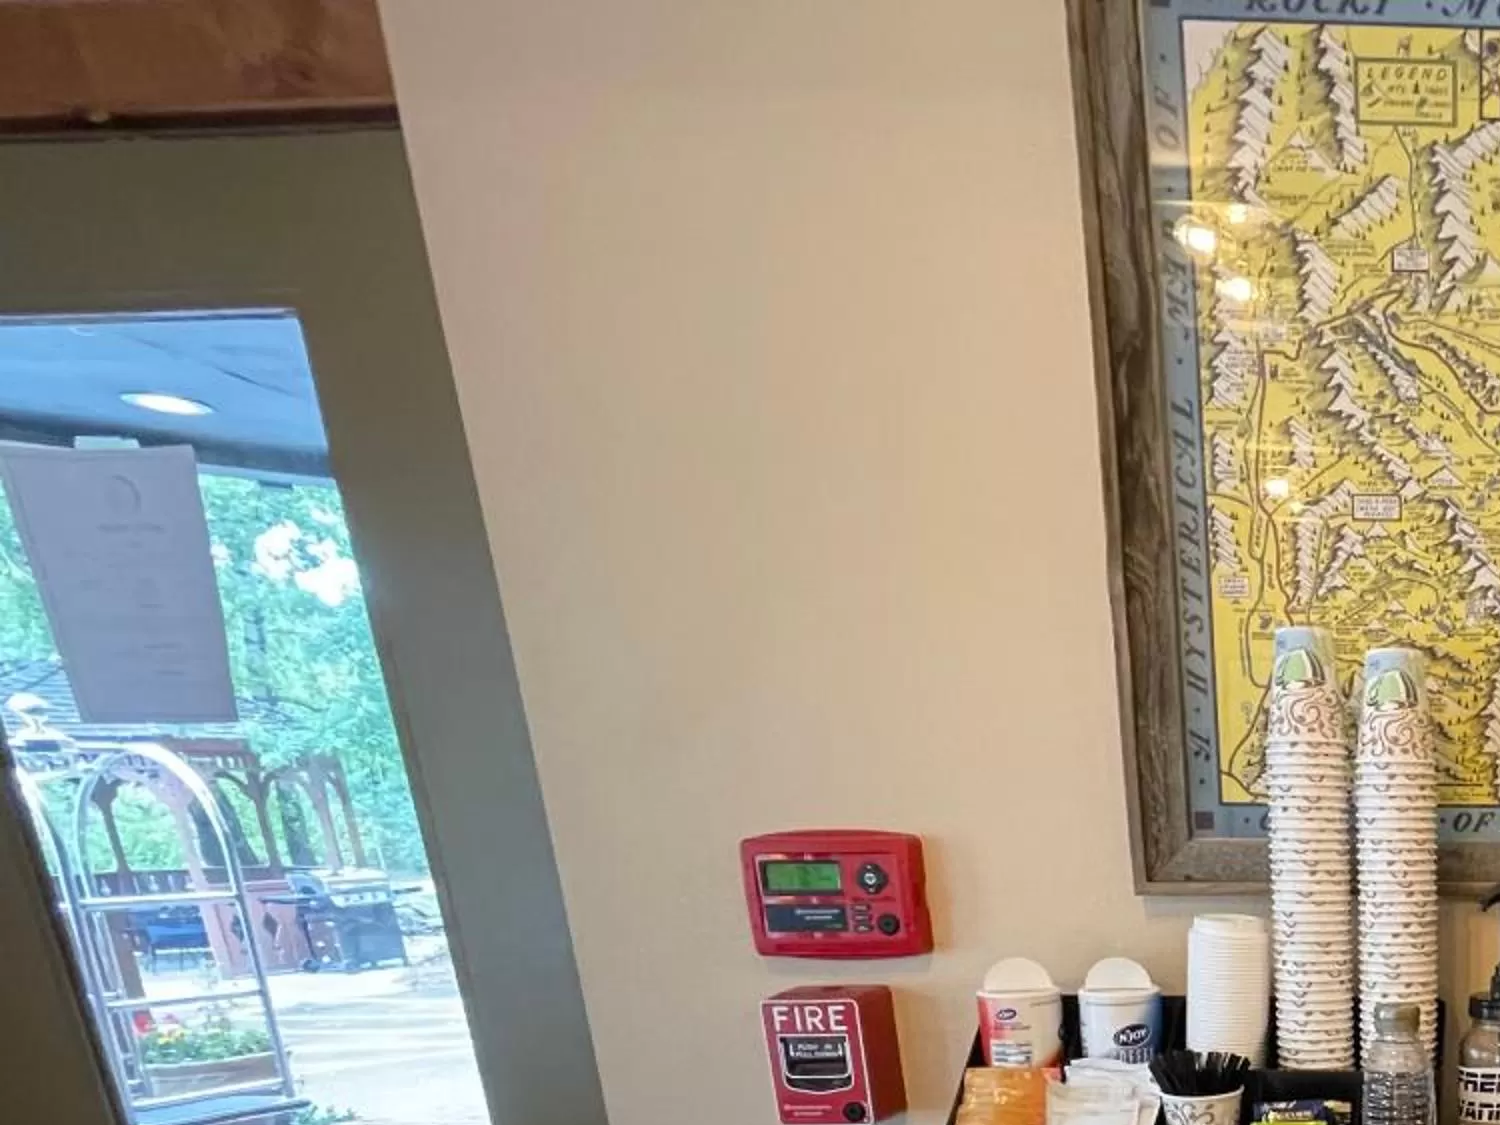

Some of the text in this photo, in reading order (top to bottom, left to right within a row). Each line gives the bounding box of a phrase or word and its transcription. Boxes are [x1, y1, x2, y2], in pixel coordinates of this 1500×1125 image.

[1366, 66, 1448, 81] LEGEND
[1153, 86, 1180, 150] OF
[1171, 396, 1209, 696] HYSTERICAL
[1452, 812, 1496, 833] OF
[771, 1005, 849, 1032] FIRE
